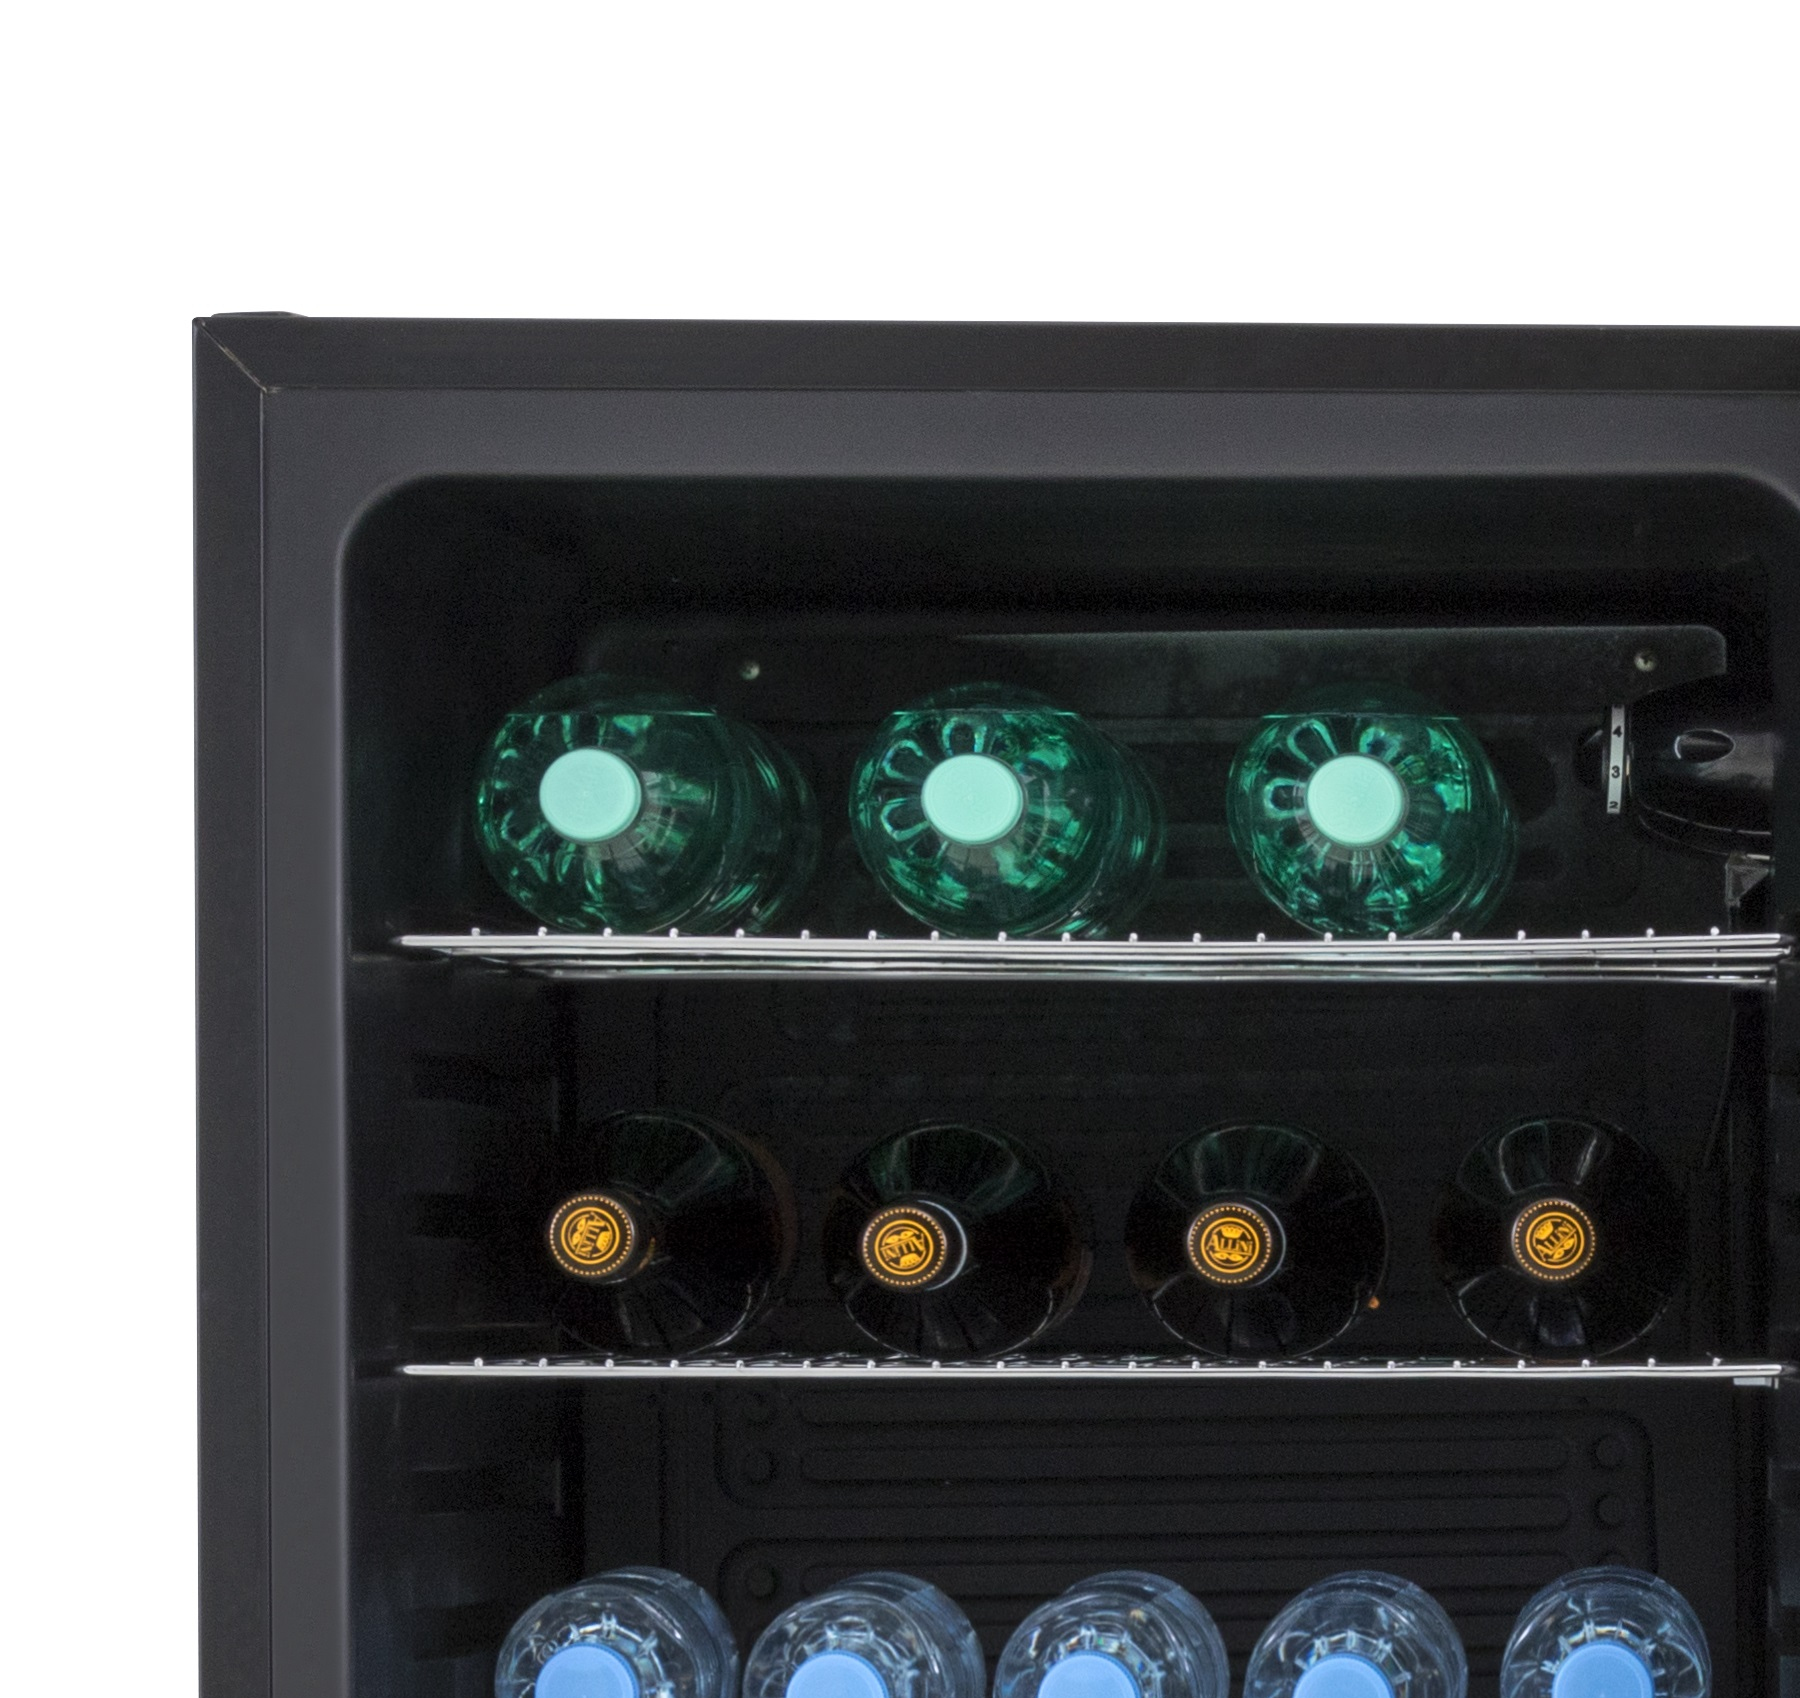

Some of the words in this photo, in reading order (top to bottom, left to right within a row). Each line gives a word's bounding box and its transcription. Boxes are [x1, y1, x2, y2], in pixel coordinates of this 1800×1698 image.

[1613, 725, 1622, 738] 4
[1611, 765, 1620, 779] 3
[1609, 801, 1619, 809] 2
